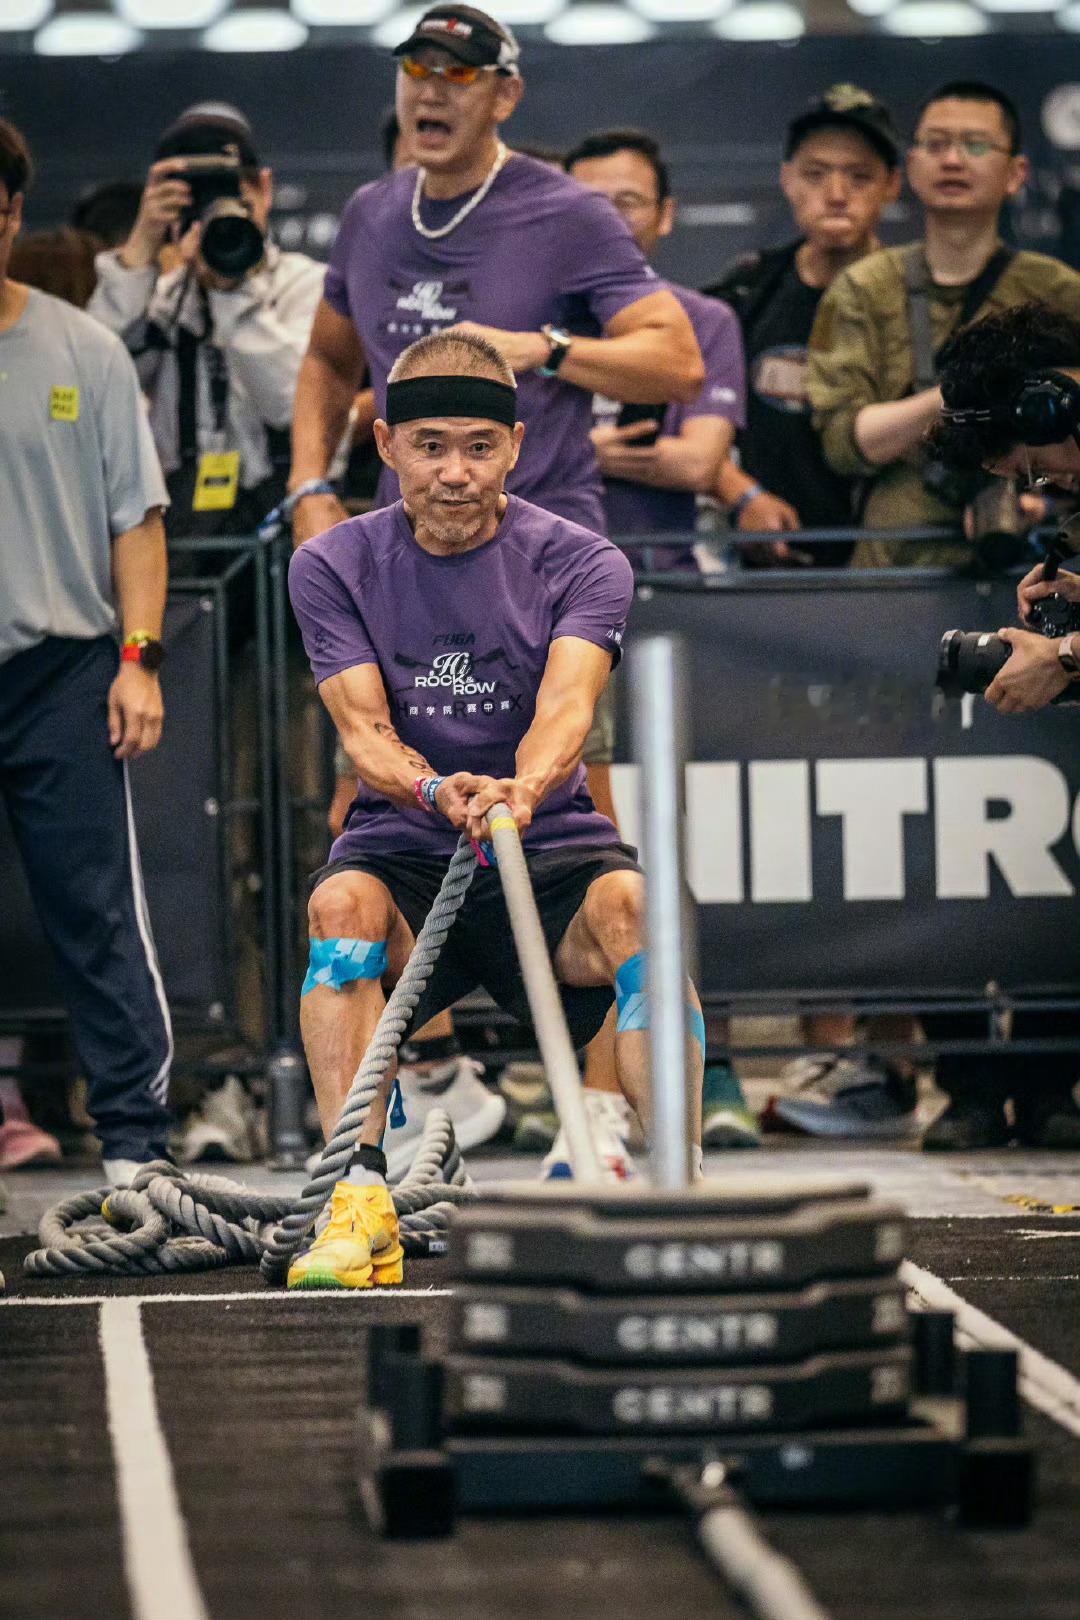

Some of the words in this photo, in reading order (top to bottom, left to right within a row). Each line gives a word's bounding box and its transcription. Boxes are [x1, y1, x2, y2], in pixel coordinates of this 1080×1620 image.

[415, 674, 466, 688] ROCK
[453, 681, 496, 696] ROW
[609, 754, 1080, 904] NITR
